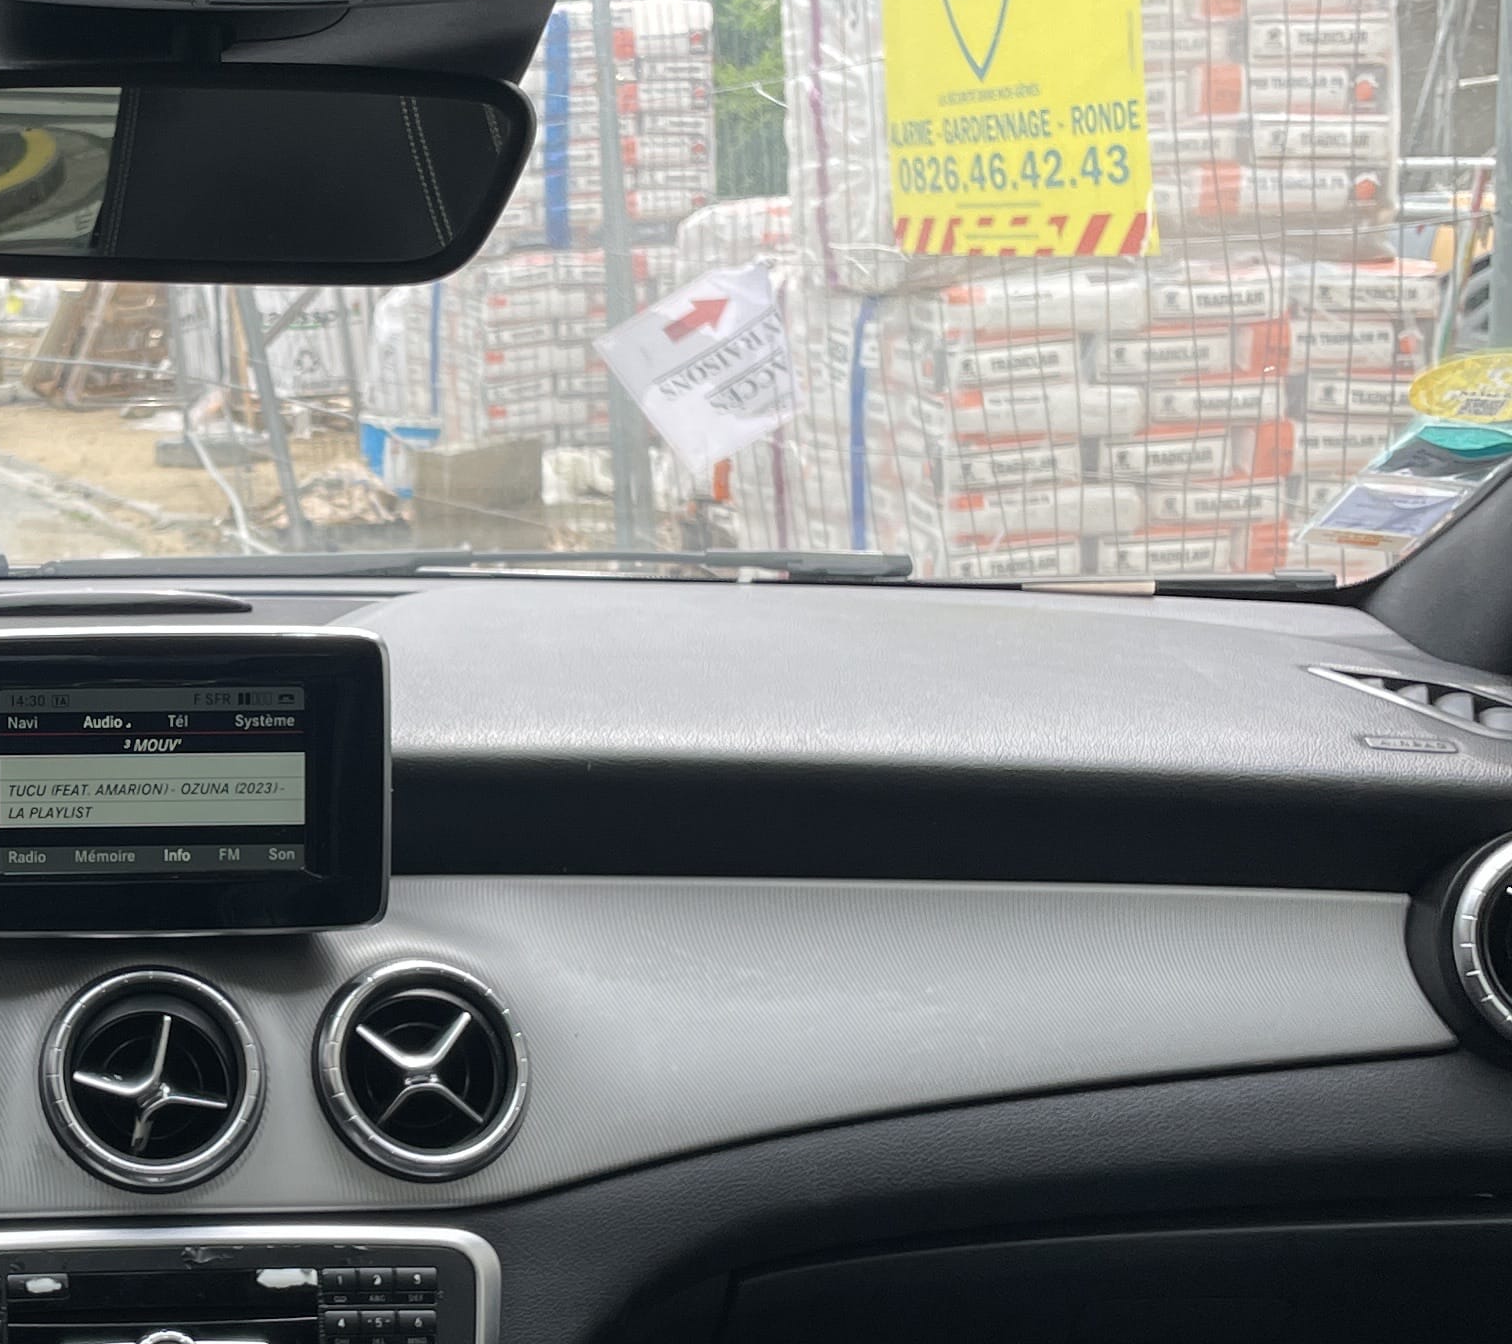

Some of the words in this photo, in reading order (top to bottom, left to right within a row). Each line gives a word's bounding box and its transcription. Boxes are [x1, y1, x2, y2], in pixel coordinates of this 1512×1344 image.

[942, 109, 1051, 146] GARDIENNAGE
[1071, 100, 1141, 135] RONDE
[899, 144, 1131, 194] 0826.46.42.43
[10, 694, 46, 707] 14:30
[193, 693, 201, 705] F
[206, 692, 231, 705] SFR
[7, 716, 39, 729] Navi
[83, 715, 123, 729] Audio
[168, 714, 188, 728] Tél
[235, 713, 295, 731] Système
[133, 738, 182, 752] MOUV'
[8, 784, 47, 797] TUCU
[51, 783, 90, 797] (FEAT.
[180, 782, 230, 796] OZUNA
[8, 807, 25, 819] LA
[29, 806, 93, 819] PLAYLIST
[8, 850, 47, 864] Radio
[75, 849, 136, 863] Mémoire
[164, 848, 191, 862] Info
[218, 847, 240, 861] FM
[268, 847, 296, 861] Son
[336, 1274, 344, 1286] 1
[372, 1273, 382, 1286] 2
[337, 1317, 346, 1328] 4
[375, 1317, 383, 1328] 5
[414, 1317, 423, 1328] 6
